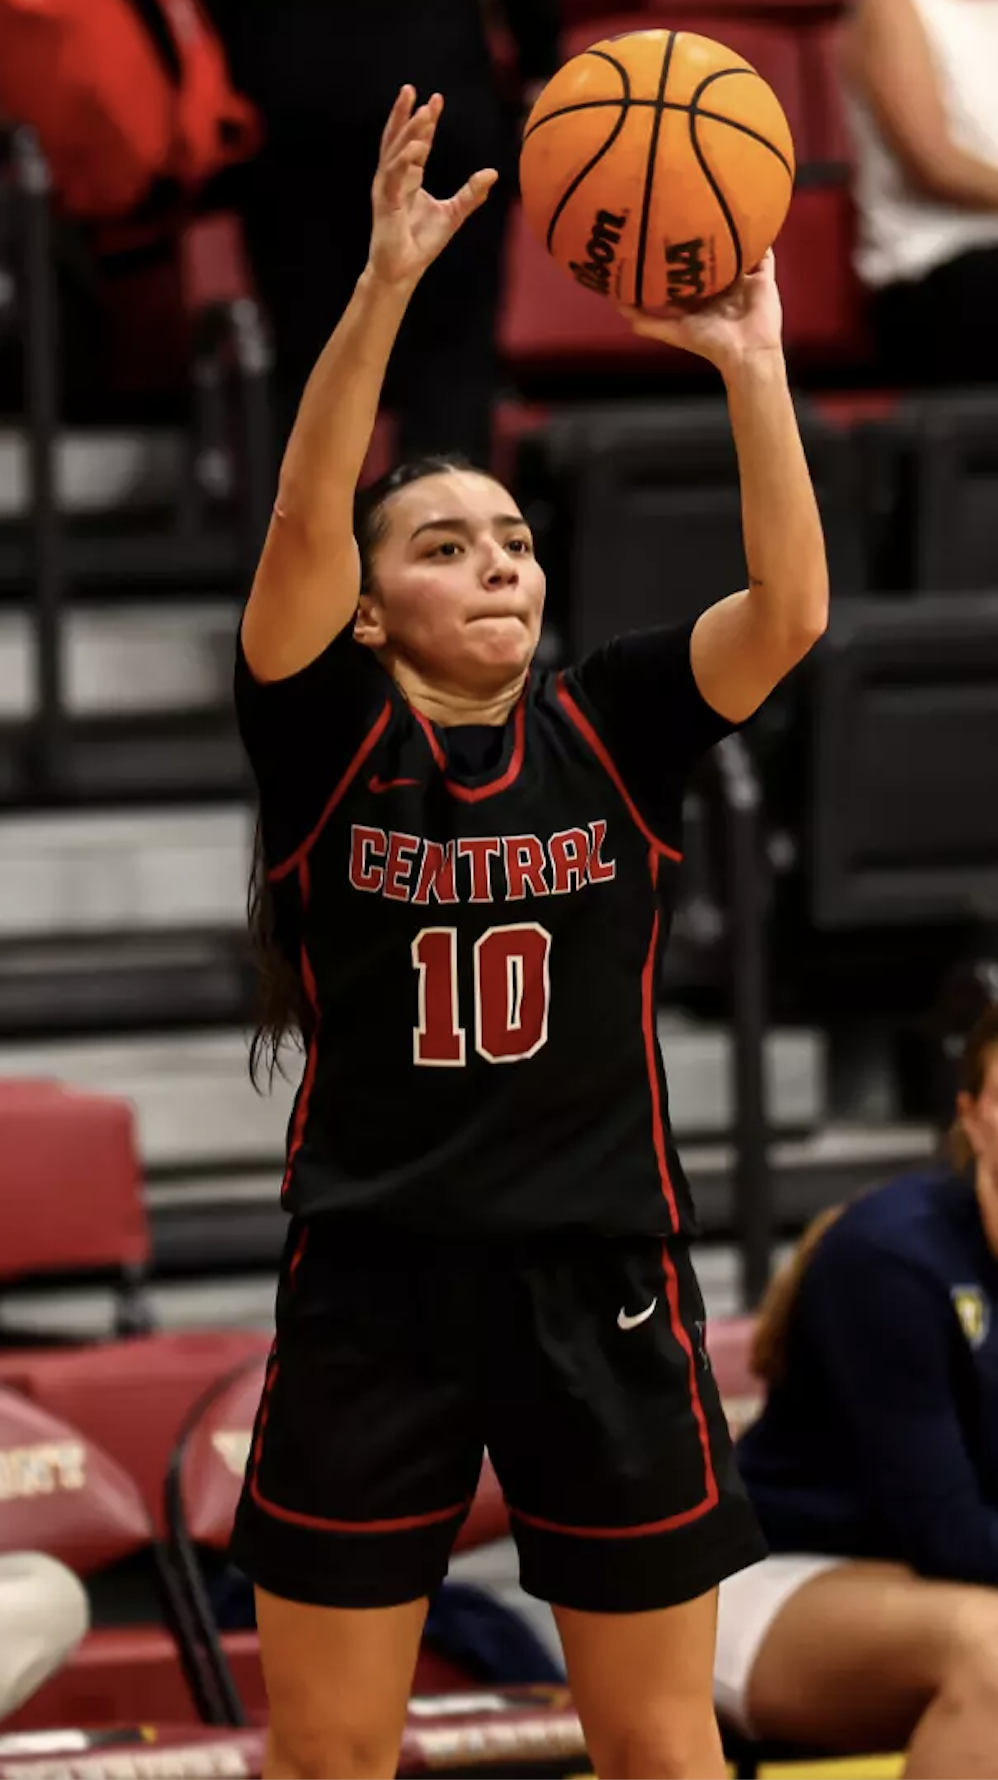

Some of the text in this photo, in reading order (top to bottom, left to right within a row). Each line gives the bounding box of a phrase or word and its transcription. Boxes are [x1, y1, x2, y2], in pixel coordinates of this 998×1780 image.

[664, 236, 705, 303] CAA
[349, 818, 616, 905] CENTRAL
[411, 921, 552, 1068] 10
